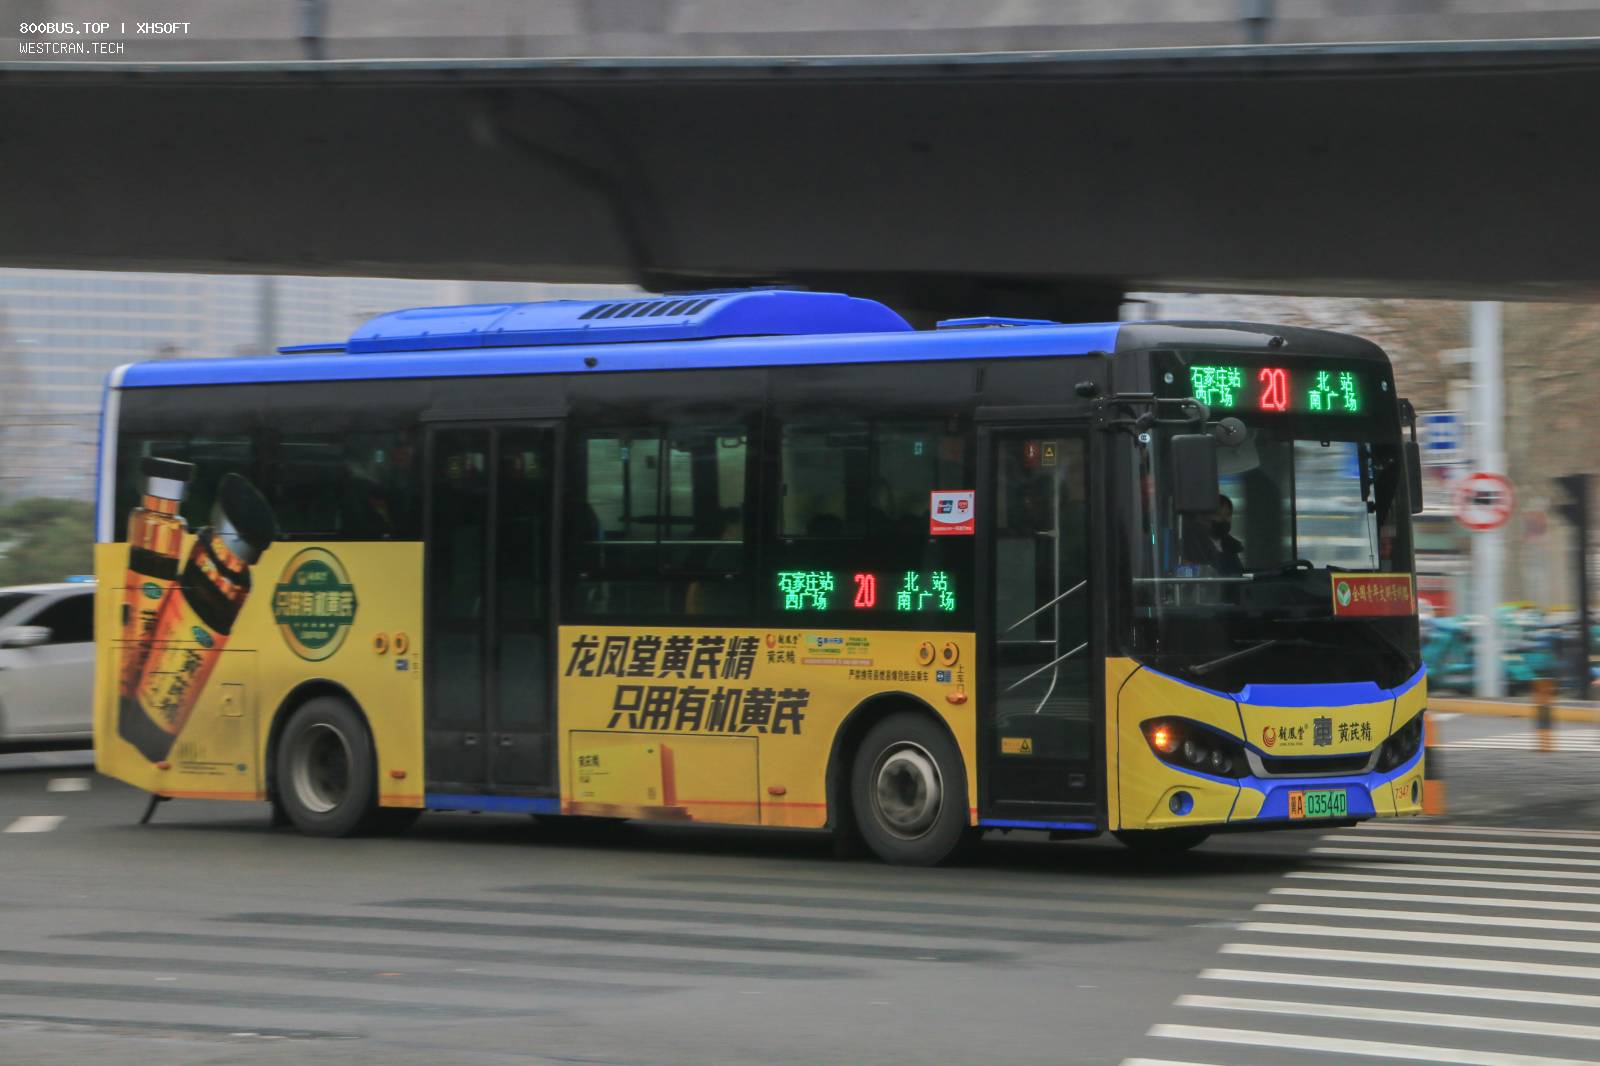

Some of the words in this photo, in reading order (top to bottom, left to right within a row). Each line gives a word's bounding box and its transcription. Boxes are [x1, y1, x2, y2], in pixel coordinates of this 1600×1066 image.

[1191, 367, 1241, 387] 石家庄站
[1259, 367, 1287, 410] 20
[1309, 390, 1358, 411] 南广场
[778, 571, 833, 591] 石家庄站
[854, 574, 876, 608] 20
[784, 590, 827, 610] 西广场
[897, 590, 955, 611] 南广场
[564, 634, 760, 680] 龙凤堂黄芪精
[606, 684, 810, 735] 只用有机黄芪
[1338, 722, 1372, 744] 黄芪精
